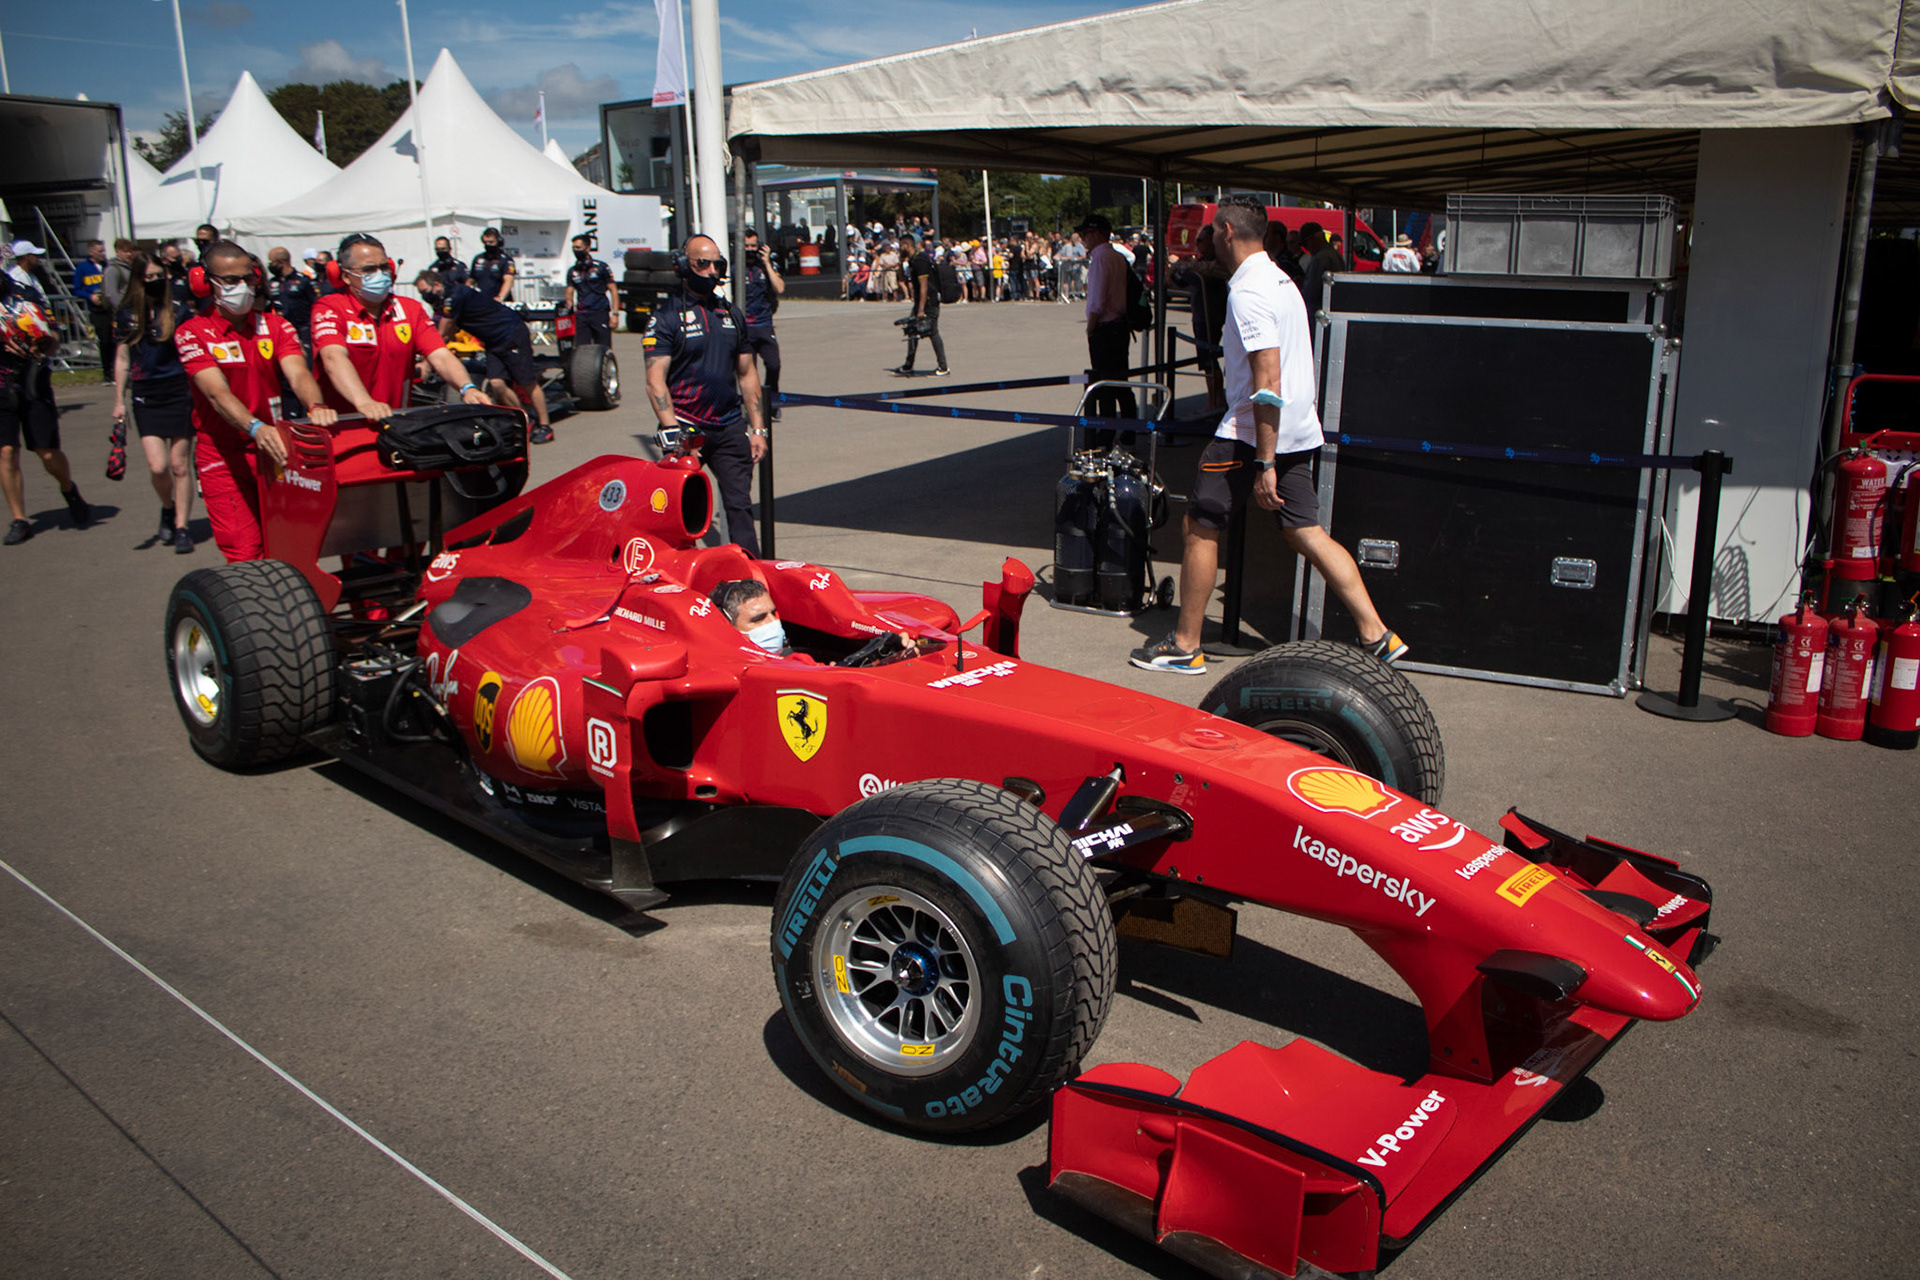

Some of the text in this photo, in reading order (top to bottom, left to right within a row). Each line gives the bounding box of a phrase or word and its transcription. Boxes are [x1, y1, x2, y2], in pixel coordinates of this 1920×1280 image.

[583, 198, 599, 252] LANE
[284, 469, 322, 492] V-Power
[603, 487, 621, 503] 433
[1861, 477, 1886, 487] WATER
[614, 606, 666, 631] RICHARD MILLE
[926, 660, 1018, 689] WEICHAI
[1239, 686, 1335, 712] PIRELLI
[1390, 808, 1450, 843] aws
[1293, 825, 1436, 917] kaspersky
[775, 847, 838, 960] PIRELLI
[925, 974, 1033, 1119] Cinturato
[1358, 1090, 1446, 1168] V-Power
